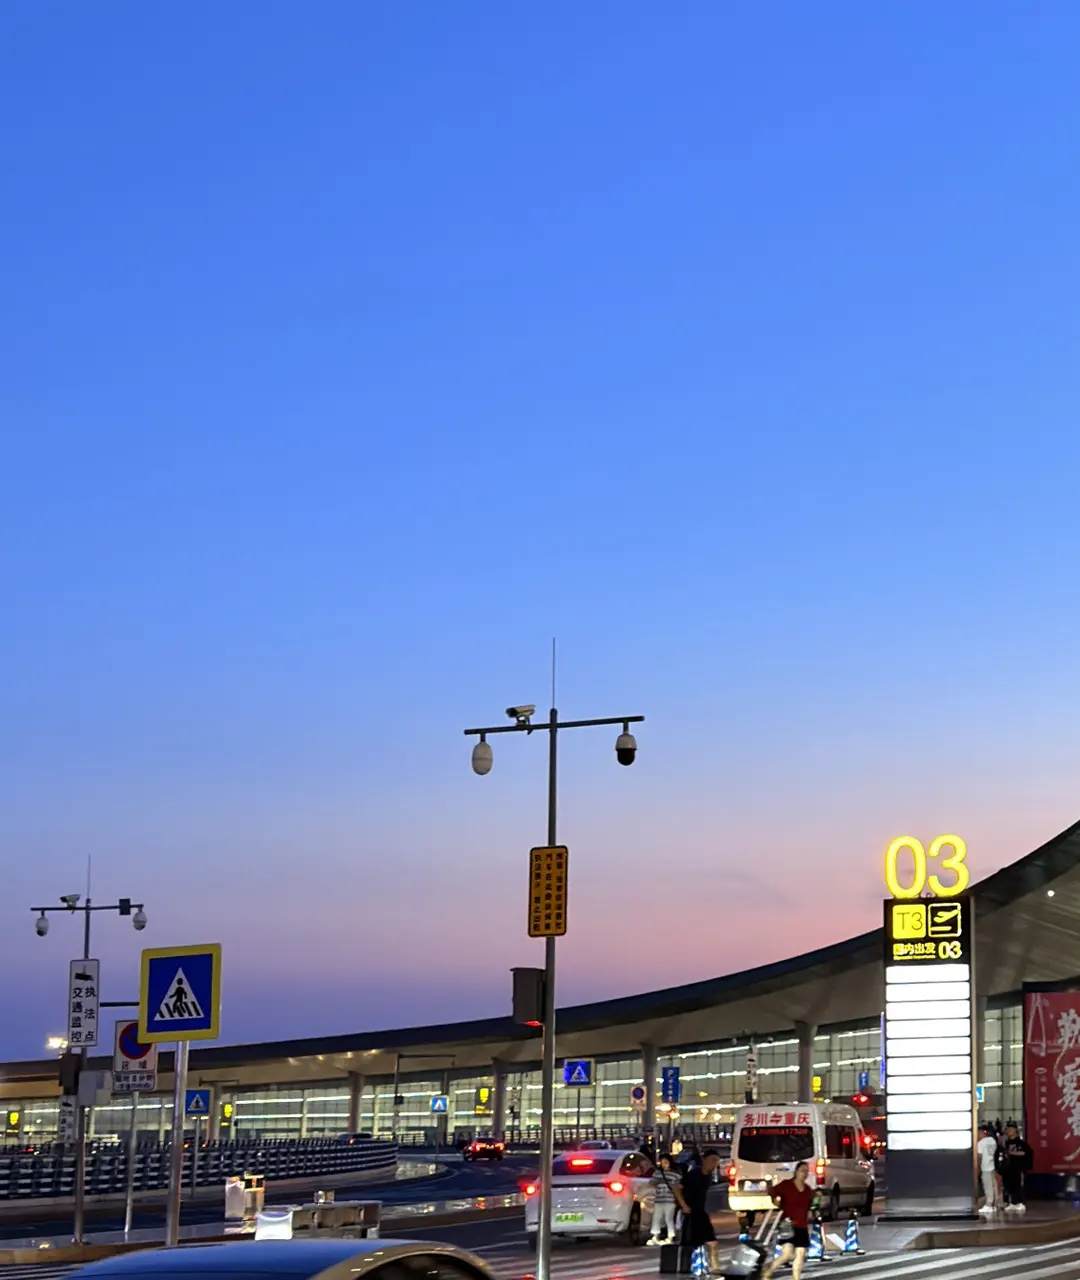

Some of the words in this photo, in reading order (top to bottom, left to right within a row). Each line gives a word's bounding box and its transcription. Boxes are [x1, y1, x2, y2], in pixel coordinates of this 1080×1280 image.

[885, 834, 969, 898] 03
[897, 911, 923, 931] T3
[893, 942, 936, 955] 国内出发
[938, 941, 962, 959] 03
[72, 987, 83, 1043] 交通监控
[84, 986, 96, 1041] 执法点
[744, 1113, 768, 1126] 务川
[784, 1112, 811, 1125] 重庆
